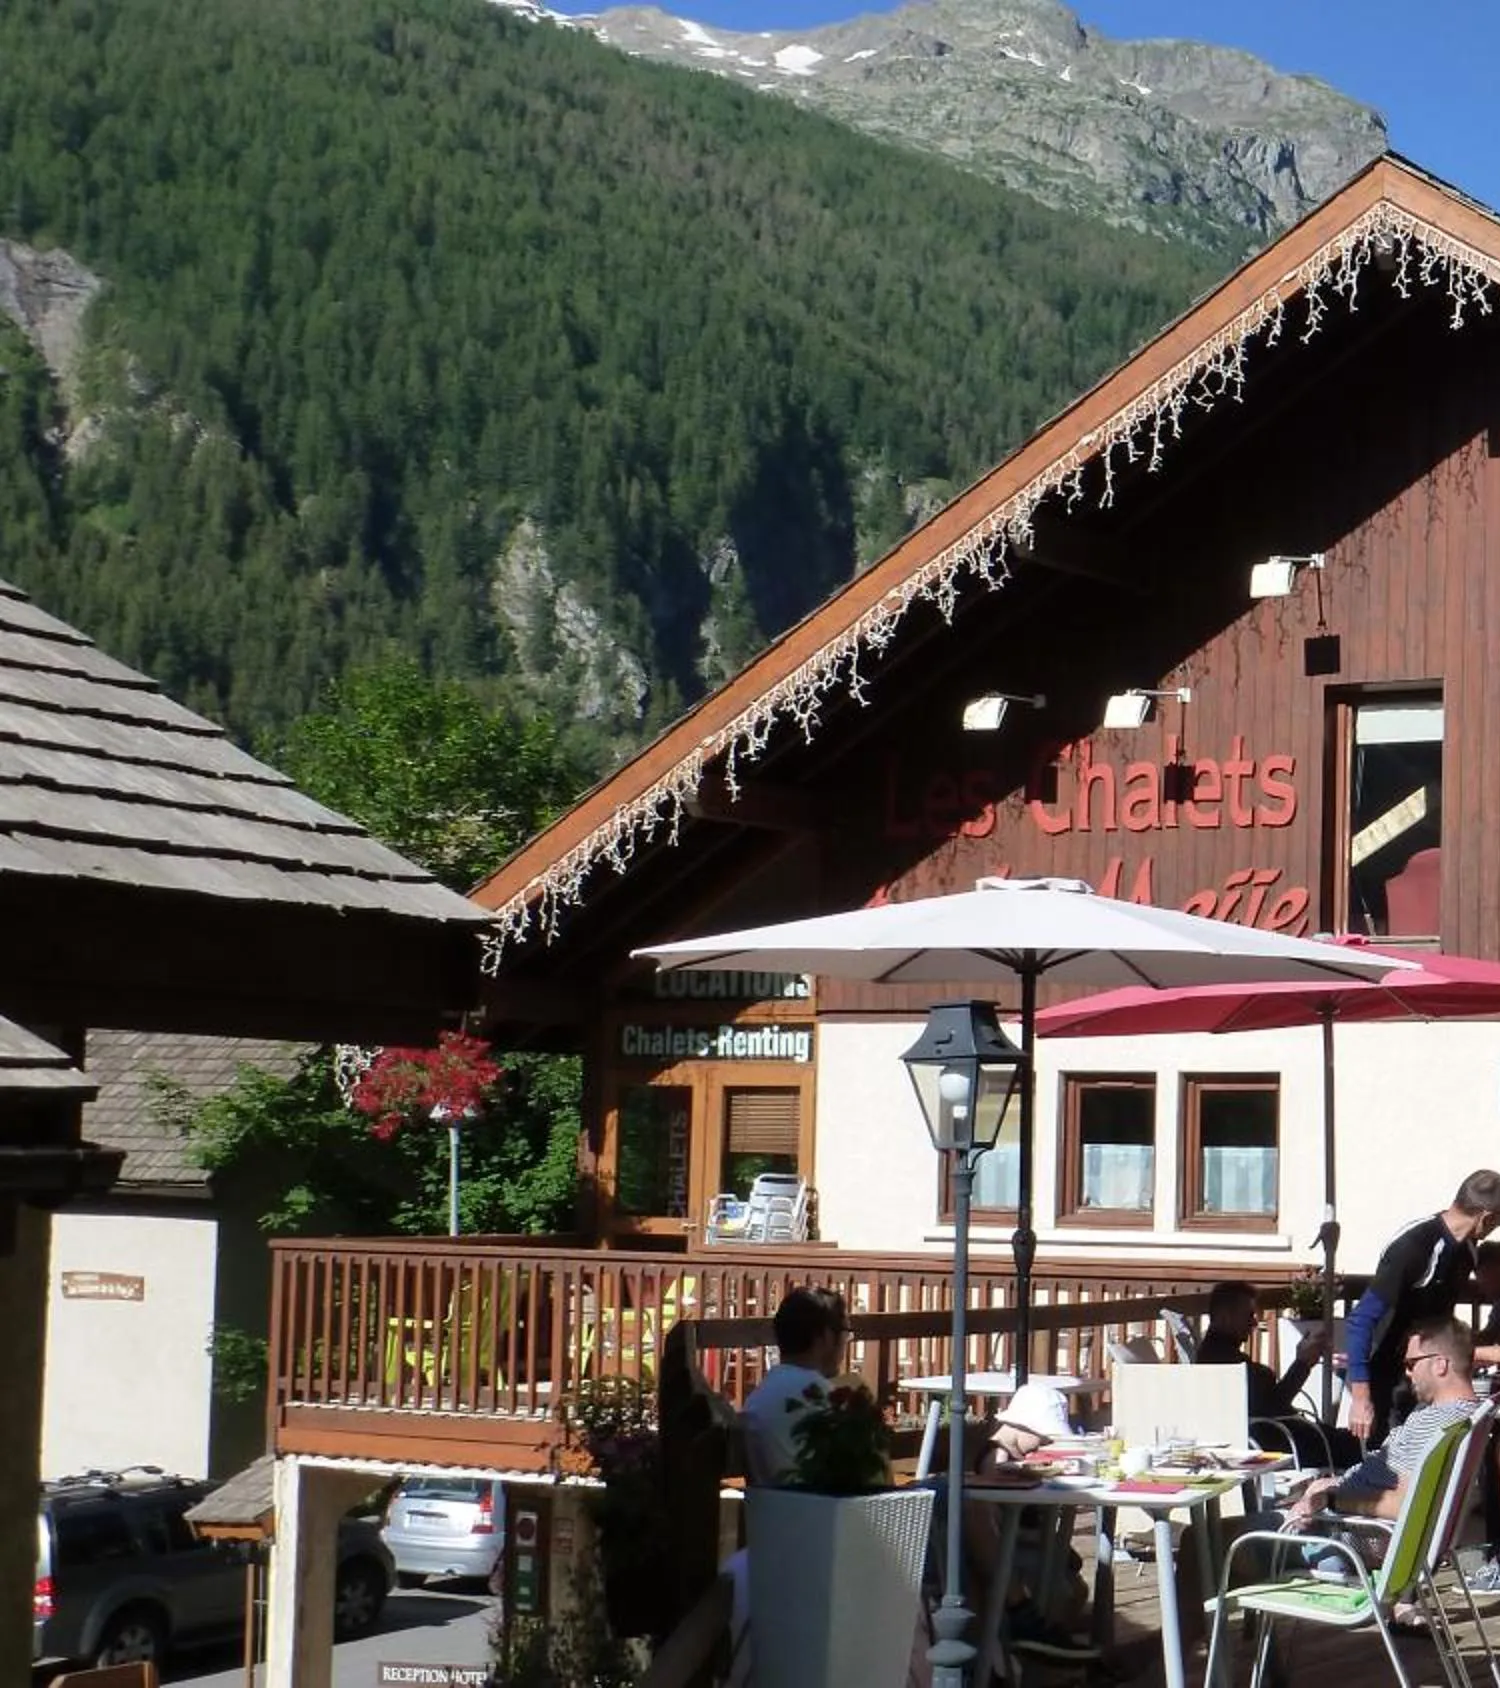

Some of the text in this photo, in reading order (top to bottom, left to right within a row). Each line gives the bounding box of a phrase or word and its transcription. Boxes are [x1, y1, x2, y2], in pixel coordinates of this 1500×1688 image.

[882, 735, 1298, 838] Les Chalets
[654, 971, 811, 998] LOCATIONS
[621, 1025, 810, 1062] Chalets-Renting
[382, 1666, 449, 1683] RECEPTION
